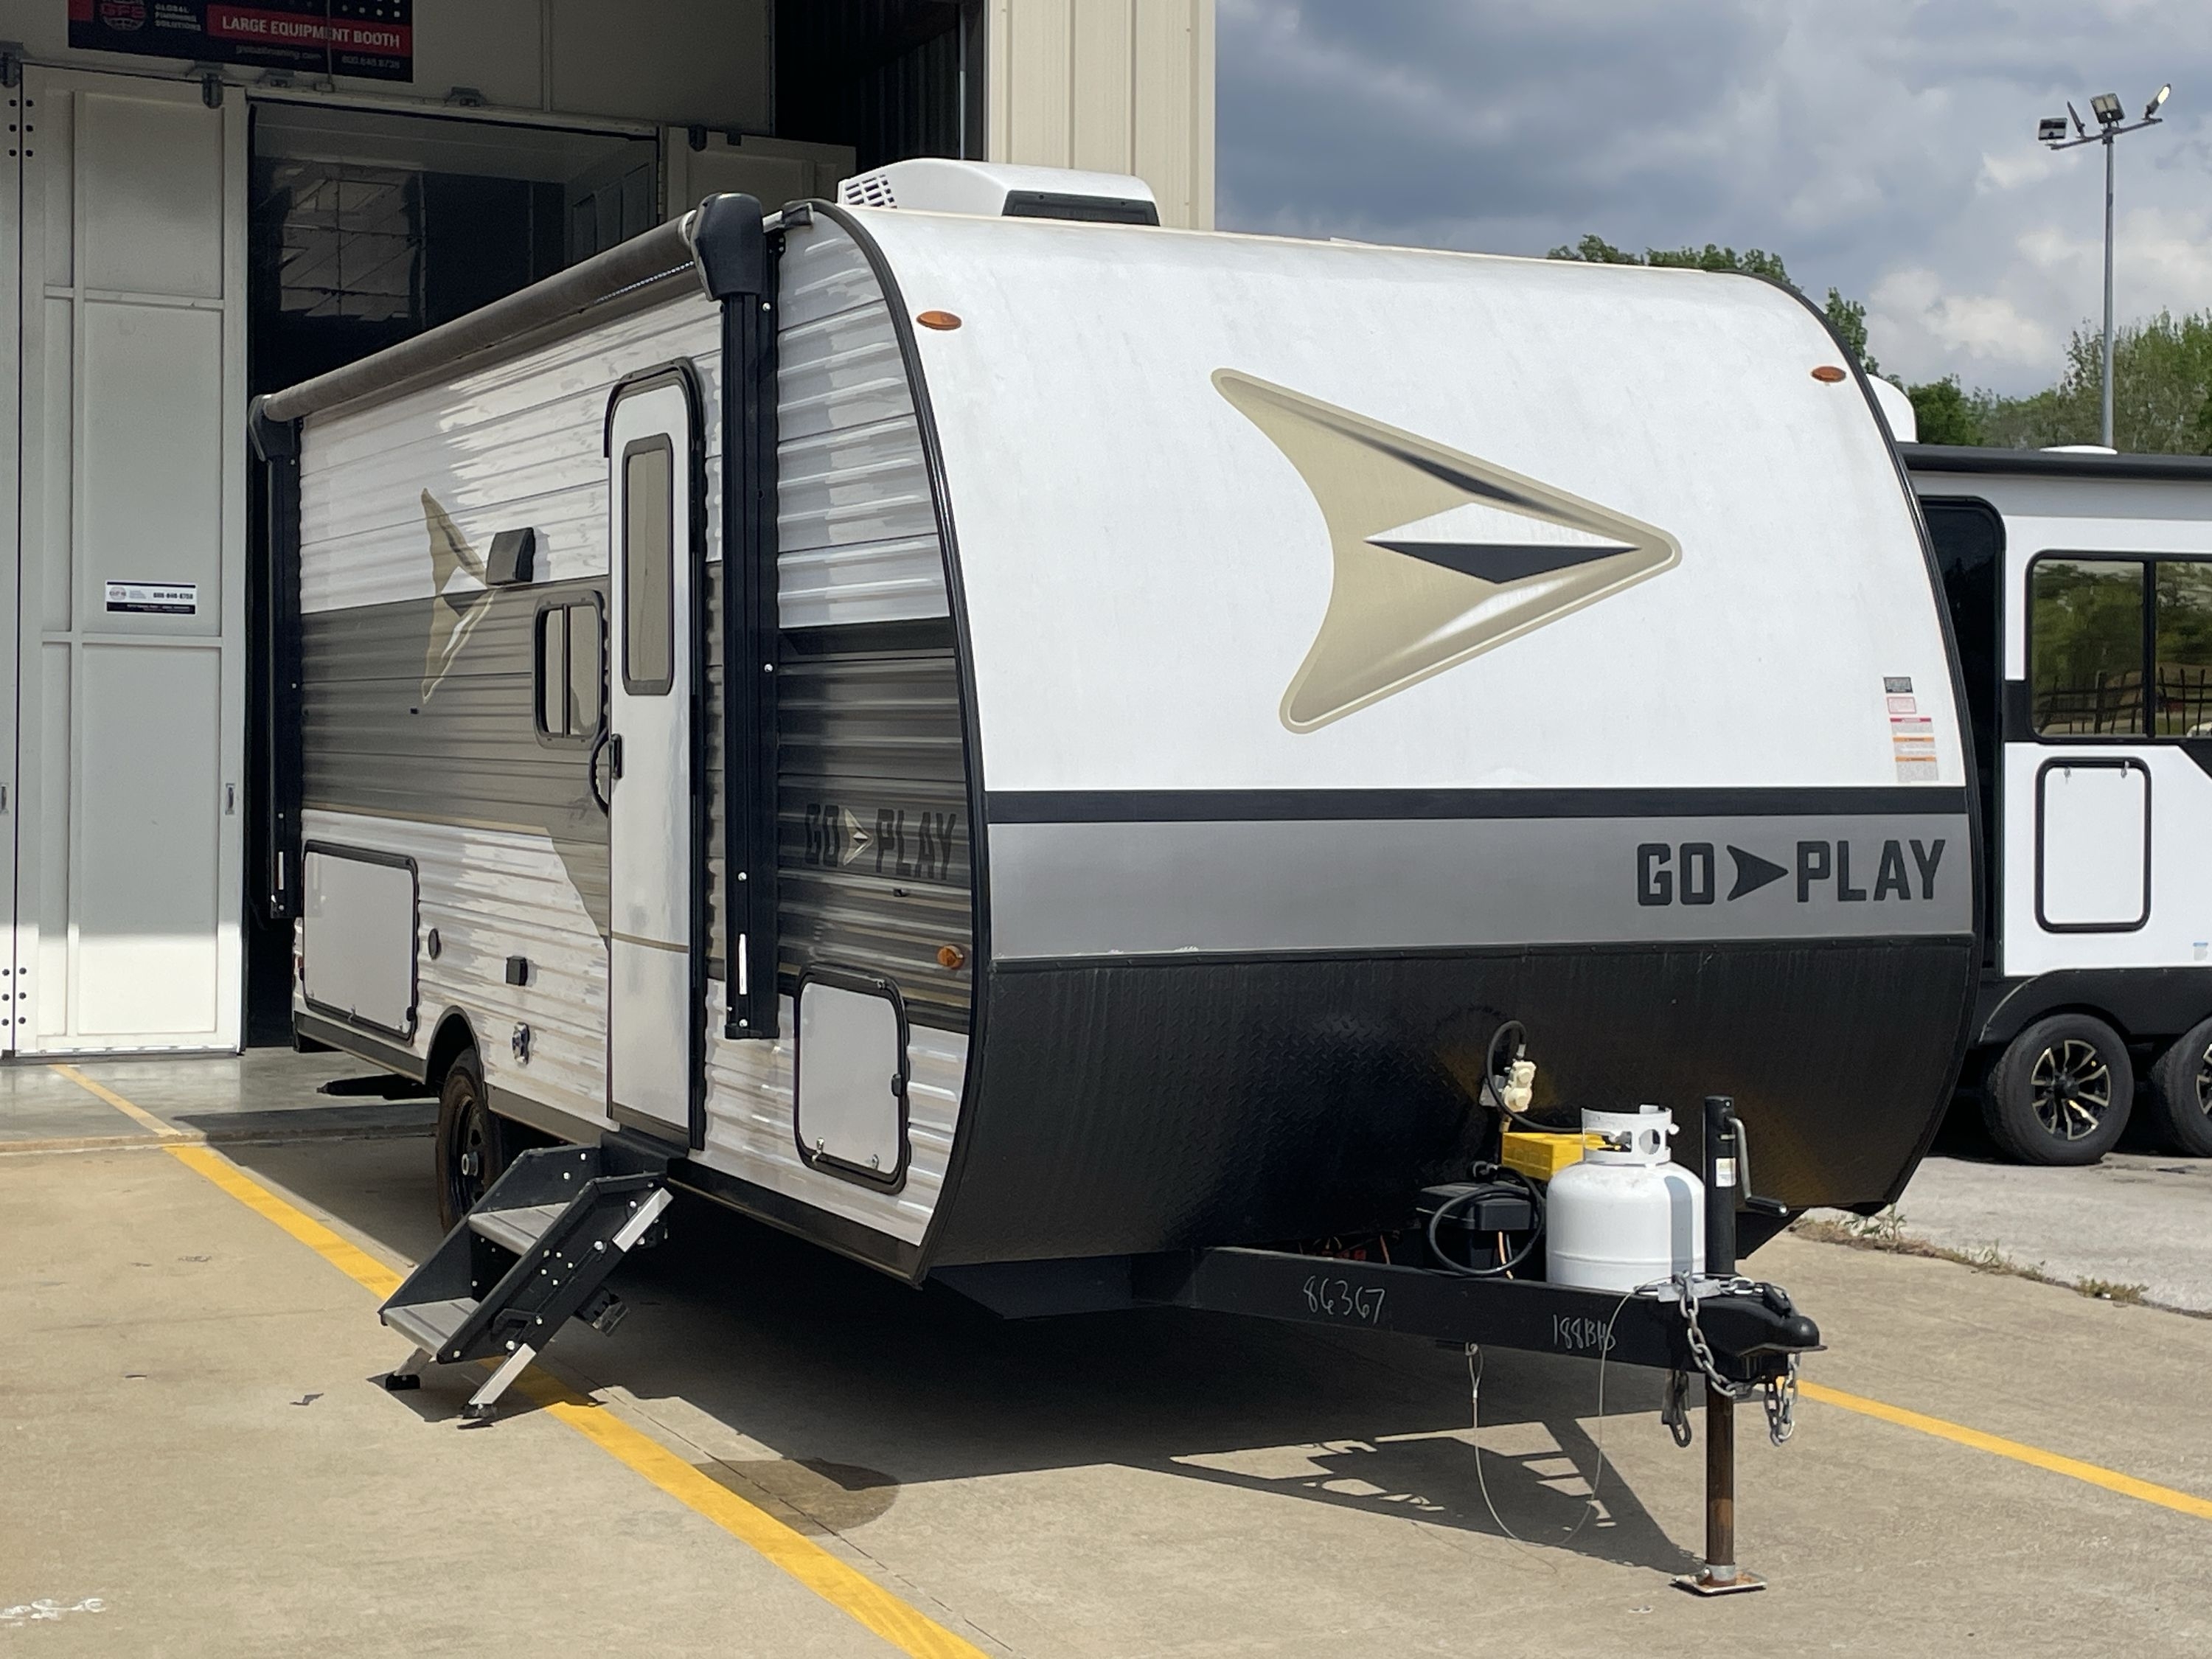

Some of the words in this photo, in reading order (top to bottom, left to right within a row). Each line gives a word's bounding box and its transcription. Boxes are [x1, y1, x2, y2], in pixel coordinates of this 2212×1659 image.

[154, 19, 202, 32] SOLUTIONS
[222, 15, 268, 33] LARGE
[271, 21, 350, 43] EQUIPMENT
[353, 29, 400, 49] BOOTH
[805, 804, 840, 866] GO
[875, 808, 956, 880] PLAY
[1637, 843, 1715, 906] GO
[1797, 839, 1946, 903] PLAY
